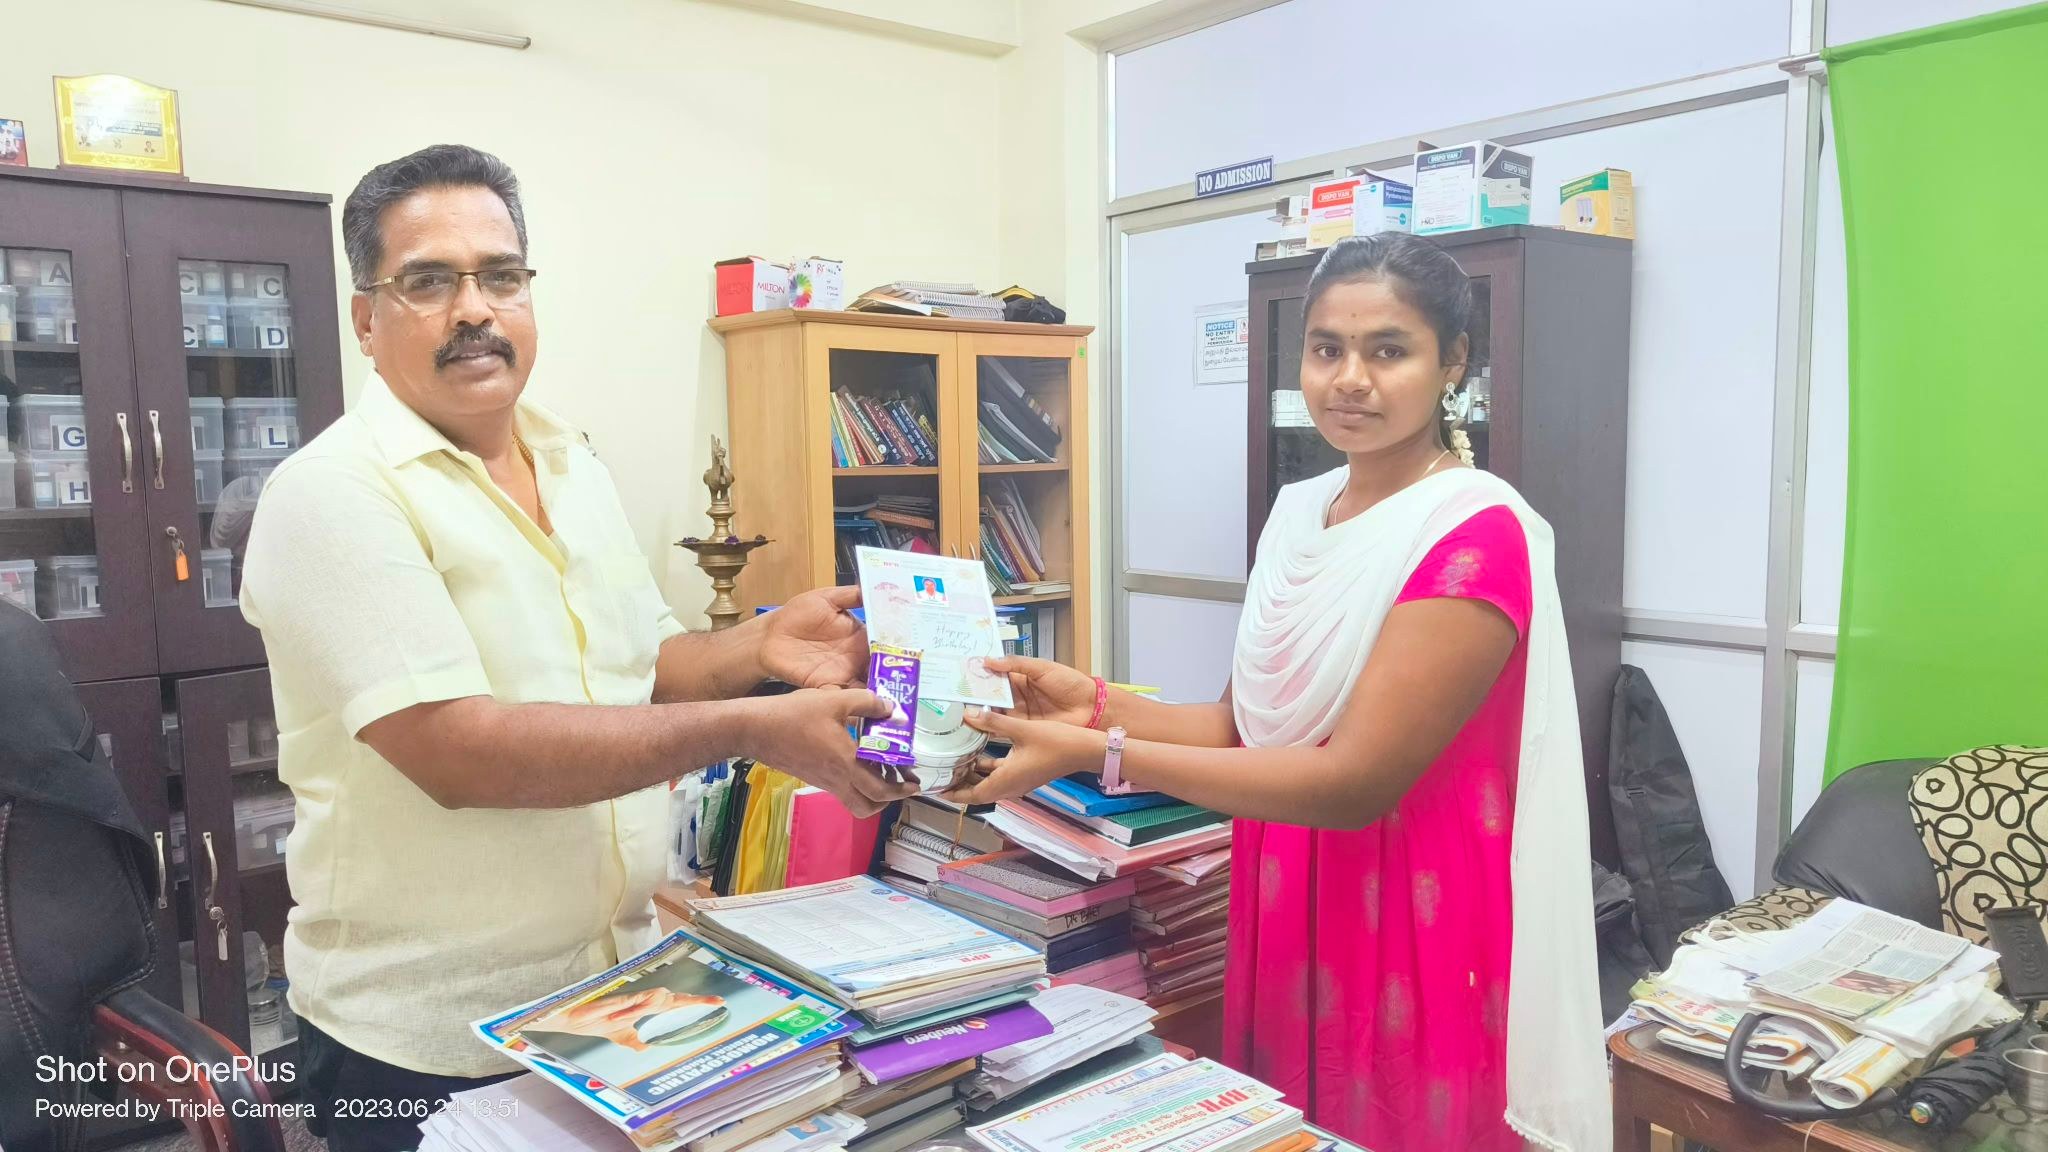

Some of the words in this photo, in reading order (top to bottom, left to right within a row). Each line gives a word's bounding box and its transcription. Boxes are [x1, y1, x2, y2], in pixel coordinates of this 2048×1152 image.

[1199, 174, 1213, 193] NO
[1214, 162, 1271, 189] ADMISSION
[49, 262, 71, 283] A
[180, 274, 195, 293] C
[263, 277, 281, 296] C
[757, 282, 785, 294] MILTON
[1206, 321, 1234, 331] NOTICE
[267, 327, 285, 346] D
[63, 426, 86, 447] G
[268, 427, 286, 446] L
[69, 481, 89, 501] H
[875, 676, 916, 696] Dairy
[903, 1025, 969, 1045] Neuberg
[648, 1032, 780, 1096] HOMOEOPATHIC
[1197, 1088, 1249, 1113] BPR
